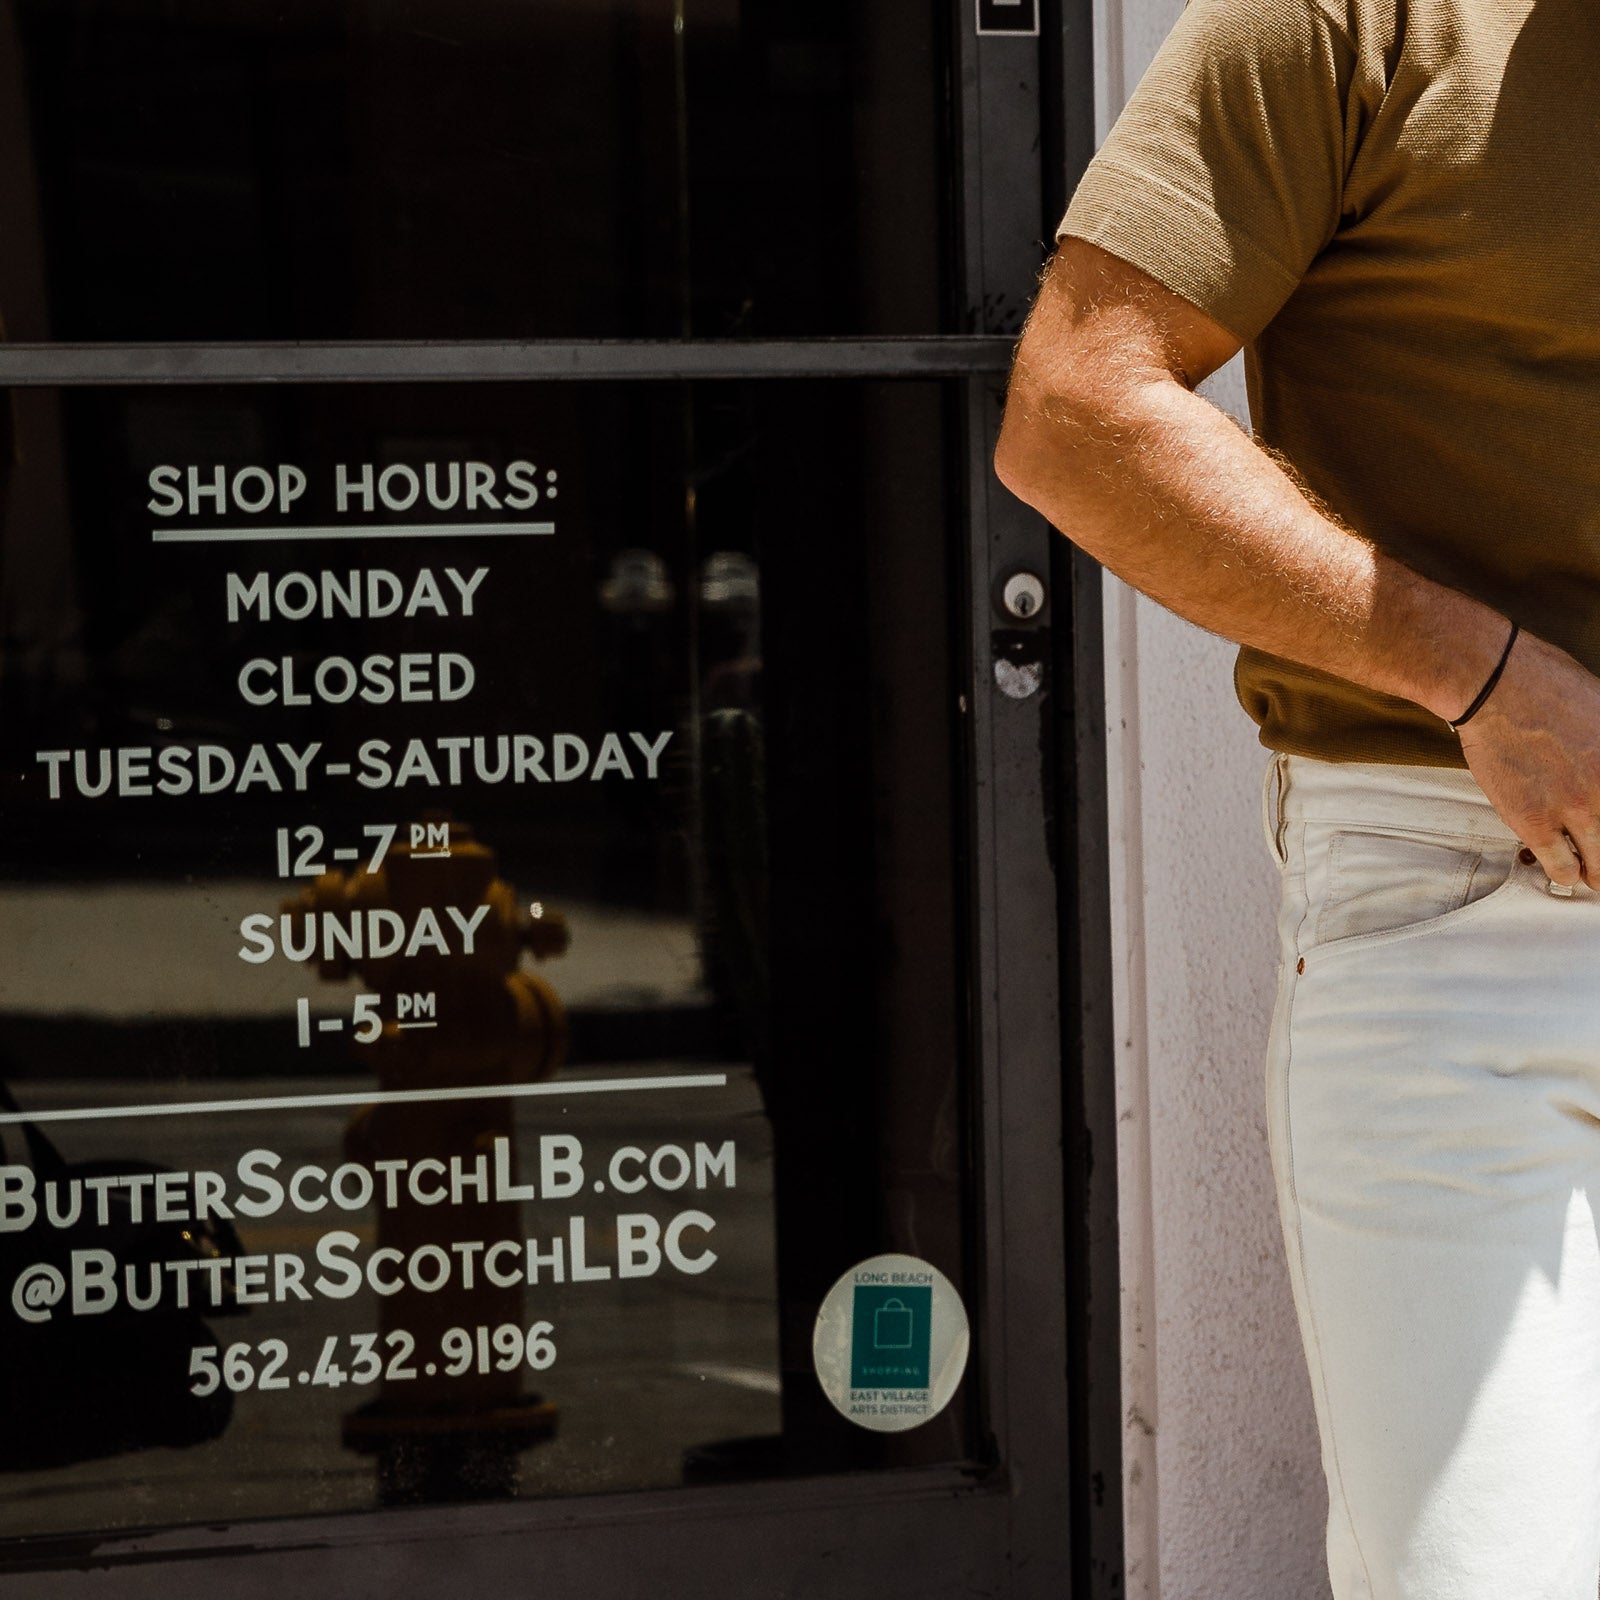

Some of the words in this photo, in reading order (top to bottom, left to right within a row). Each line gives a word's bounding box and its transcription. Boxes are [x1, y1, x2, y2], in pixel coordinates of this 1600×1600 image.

[147, 464, 307, 516] SHOP
[336, 461, 557, 512] HOURS:
[226, 568, 489, 622] MONDAY
[238, 653, 475, 705] CLOSED
[36, 732, 673, 798] TUESDAY-SATURDAY
[277, 825, 397, 877] 12-7
[410, 822, 451, 849] PM
[238, 905, 490, 964] SUNDAY
[297, 994, 382, 1047] 1-5
[397, 992, 436, 1019] PM
[855, 1273, 888, 1283] LONG
[892, 1273, 932, 1283] BEACH
[189, 1321, 557, 1396] 562.432.9196
[850, 1405, 878, 1415] ARTS
[881, 1405, 928, 1415] DISTRICT
[851, 1391, 879, 1401] EAST
[882, 1391, 928, 1401] VILLAGE
